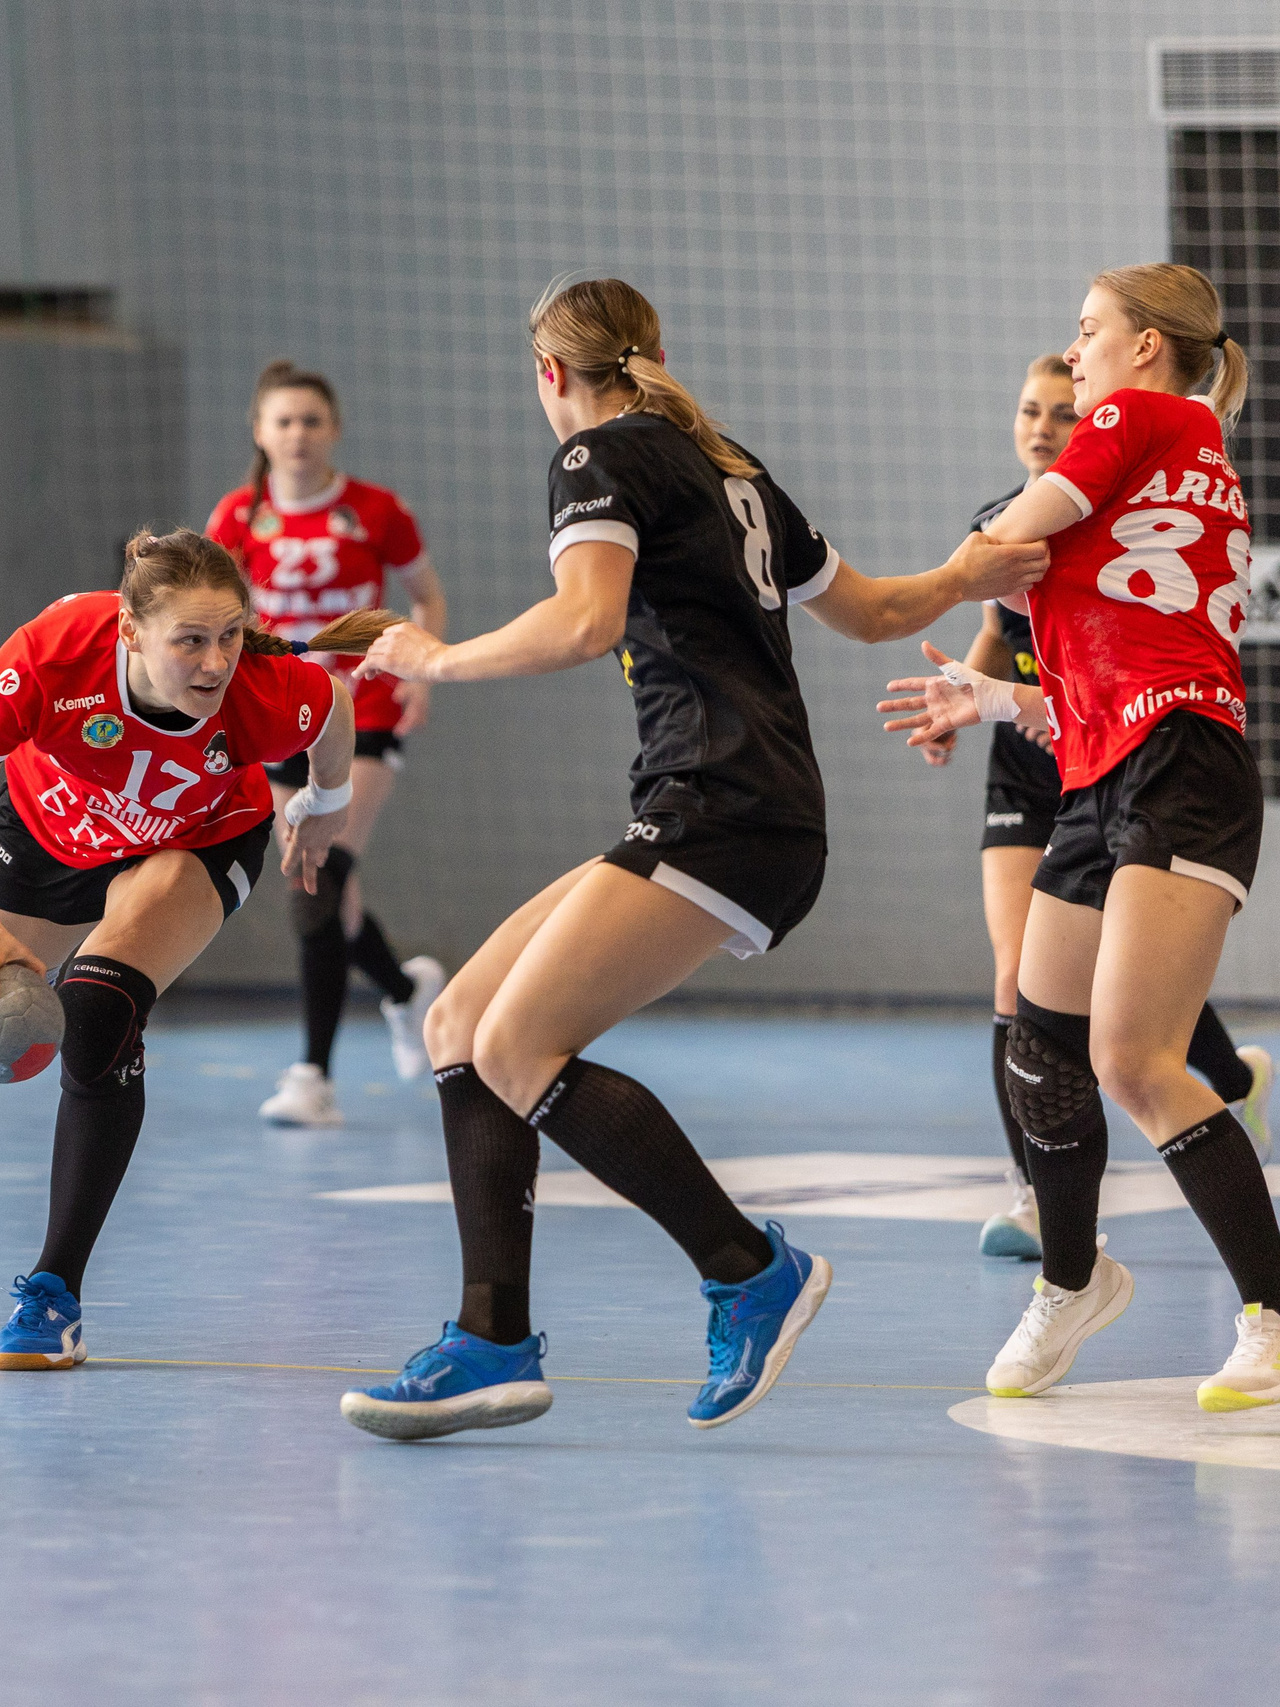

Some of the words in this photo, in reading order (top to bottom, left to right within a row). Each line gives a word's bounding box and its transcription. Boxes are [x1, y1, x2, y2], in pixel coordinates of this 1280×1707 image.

[1197, 447, 1239, 480] SPOR
[1127, 469, 1247, 520] ARLO
[269, 536, 340, 590] 23
[723, 477, 781, 610] 8
[1097, 508, 1251, 656] 88
[54, 693, 106, 713] Kempa
[1122, 682, 1204, 728] Minsk
[119, 750, 201, 811] 17
